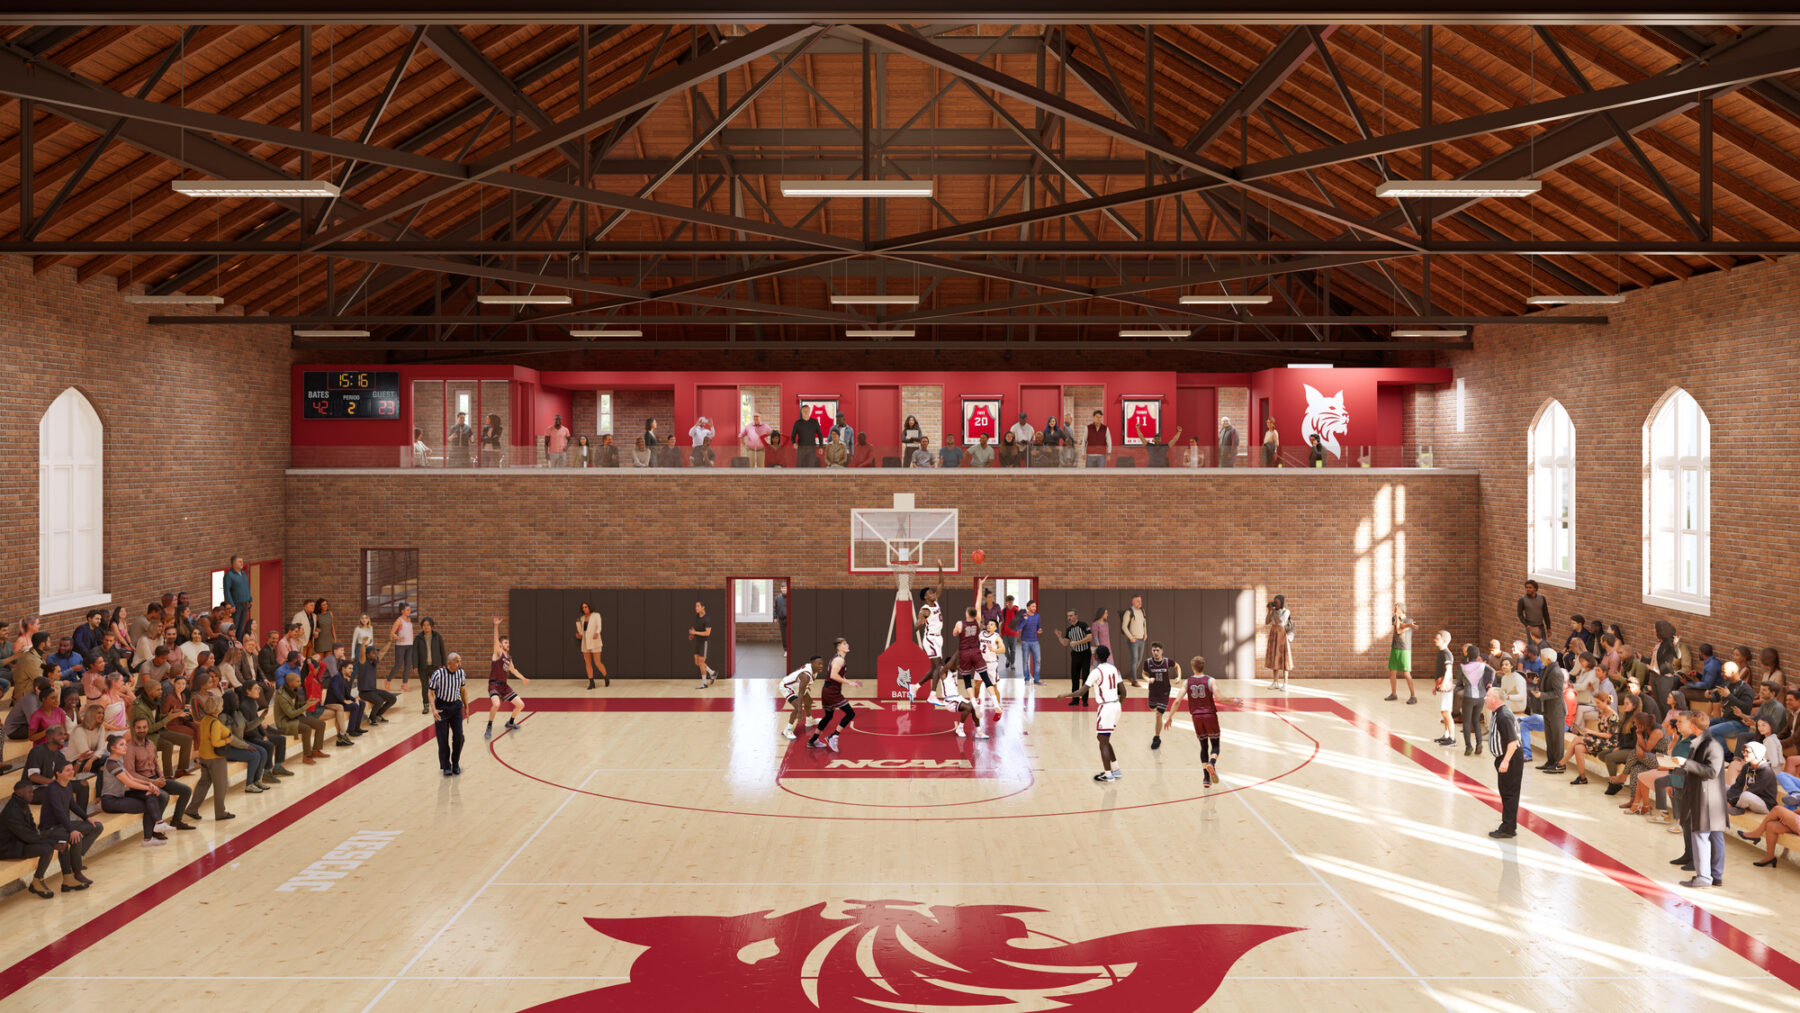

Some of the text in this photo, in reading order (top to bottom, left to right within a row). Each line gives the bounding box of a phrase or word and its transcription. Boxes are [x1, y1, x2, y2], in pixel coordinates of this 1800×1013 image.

[339, 373, 369, 388] 15:16
[308, 391, 330, 399] BATES
[313, 400, 395, 415] 42 2 23
[974, 417, 988, 427] 20
[1108, 673, 1116, 689] 11
[1190, 684, 1206, 699] 33
[824, 759, 973, 769] NCAA
[274, 830, 405, 892] NESCAC
